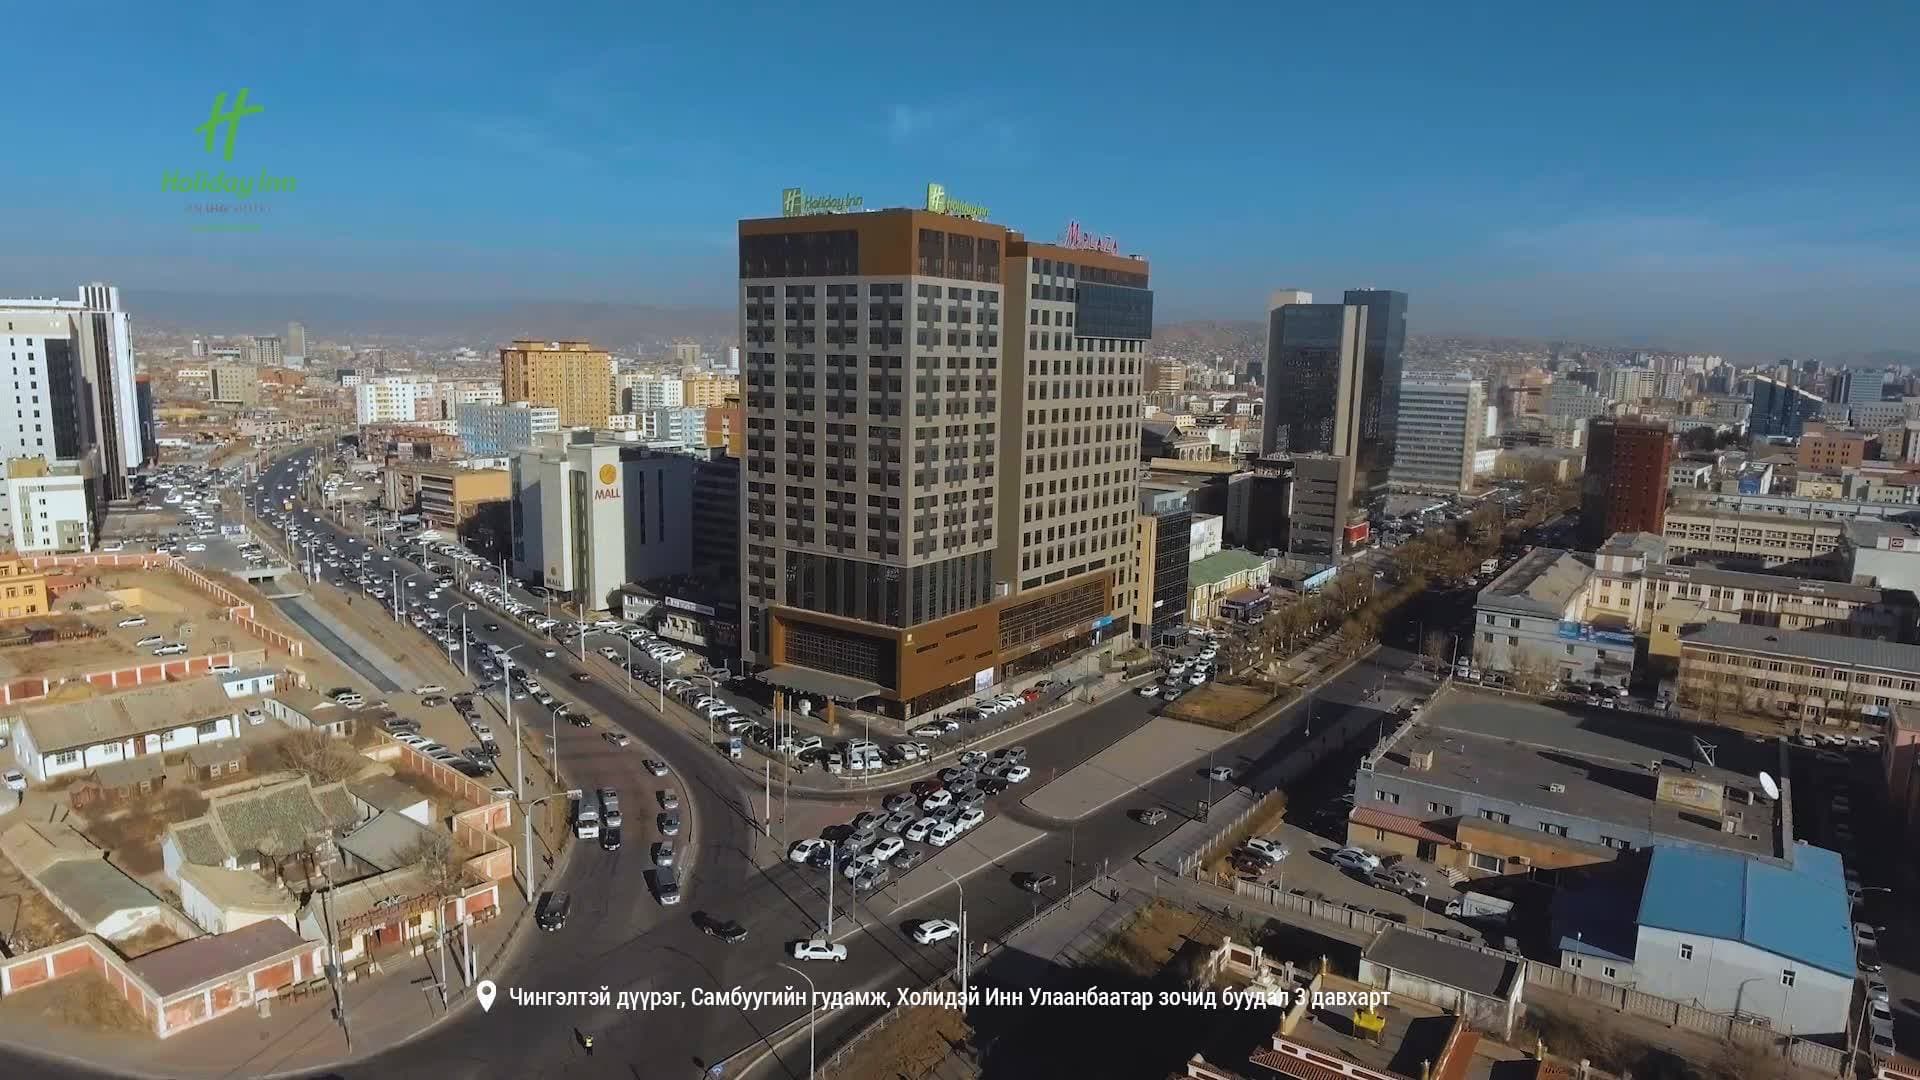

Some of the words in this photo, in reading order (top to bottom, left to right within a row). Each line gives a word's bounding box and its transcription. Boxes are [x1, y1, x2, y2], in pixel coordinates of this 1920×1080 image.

[804, 195, 845, 210] Holiday
[846, 192, 863, 206] Inn
[1082, 231, 1118, 255] PLAZA
[594, 487, 621, 500] MALL
